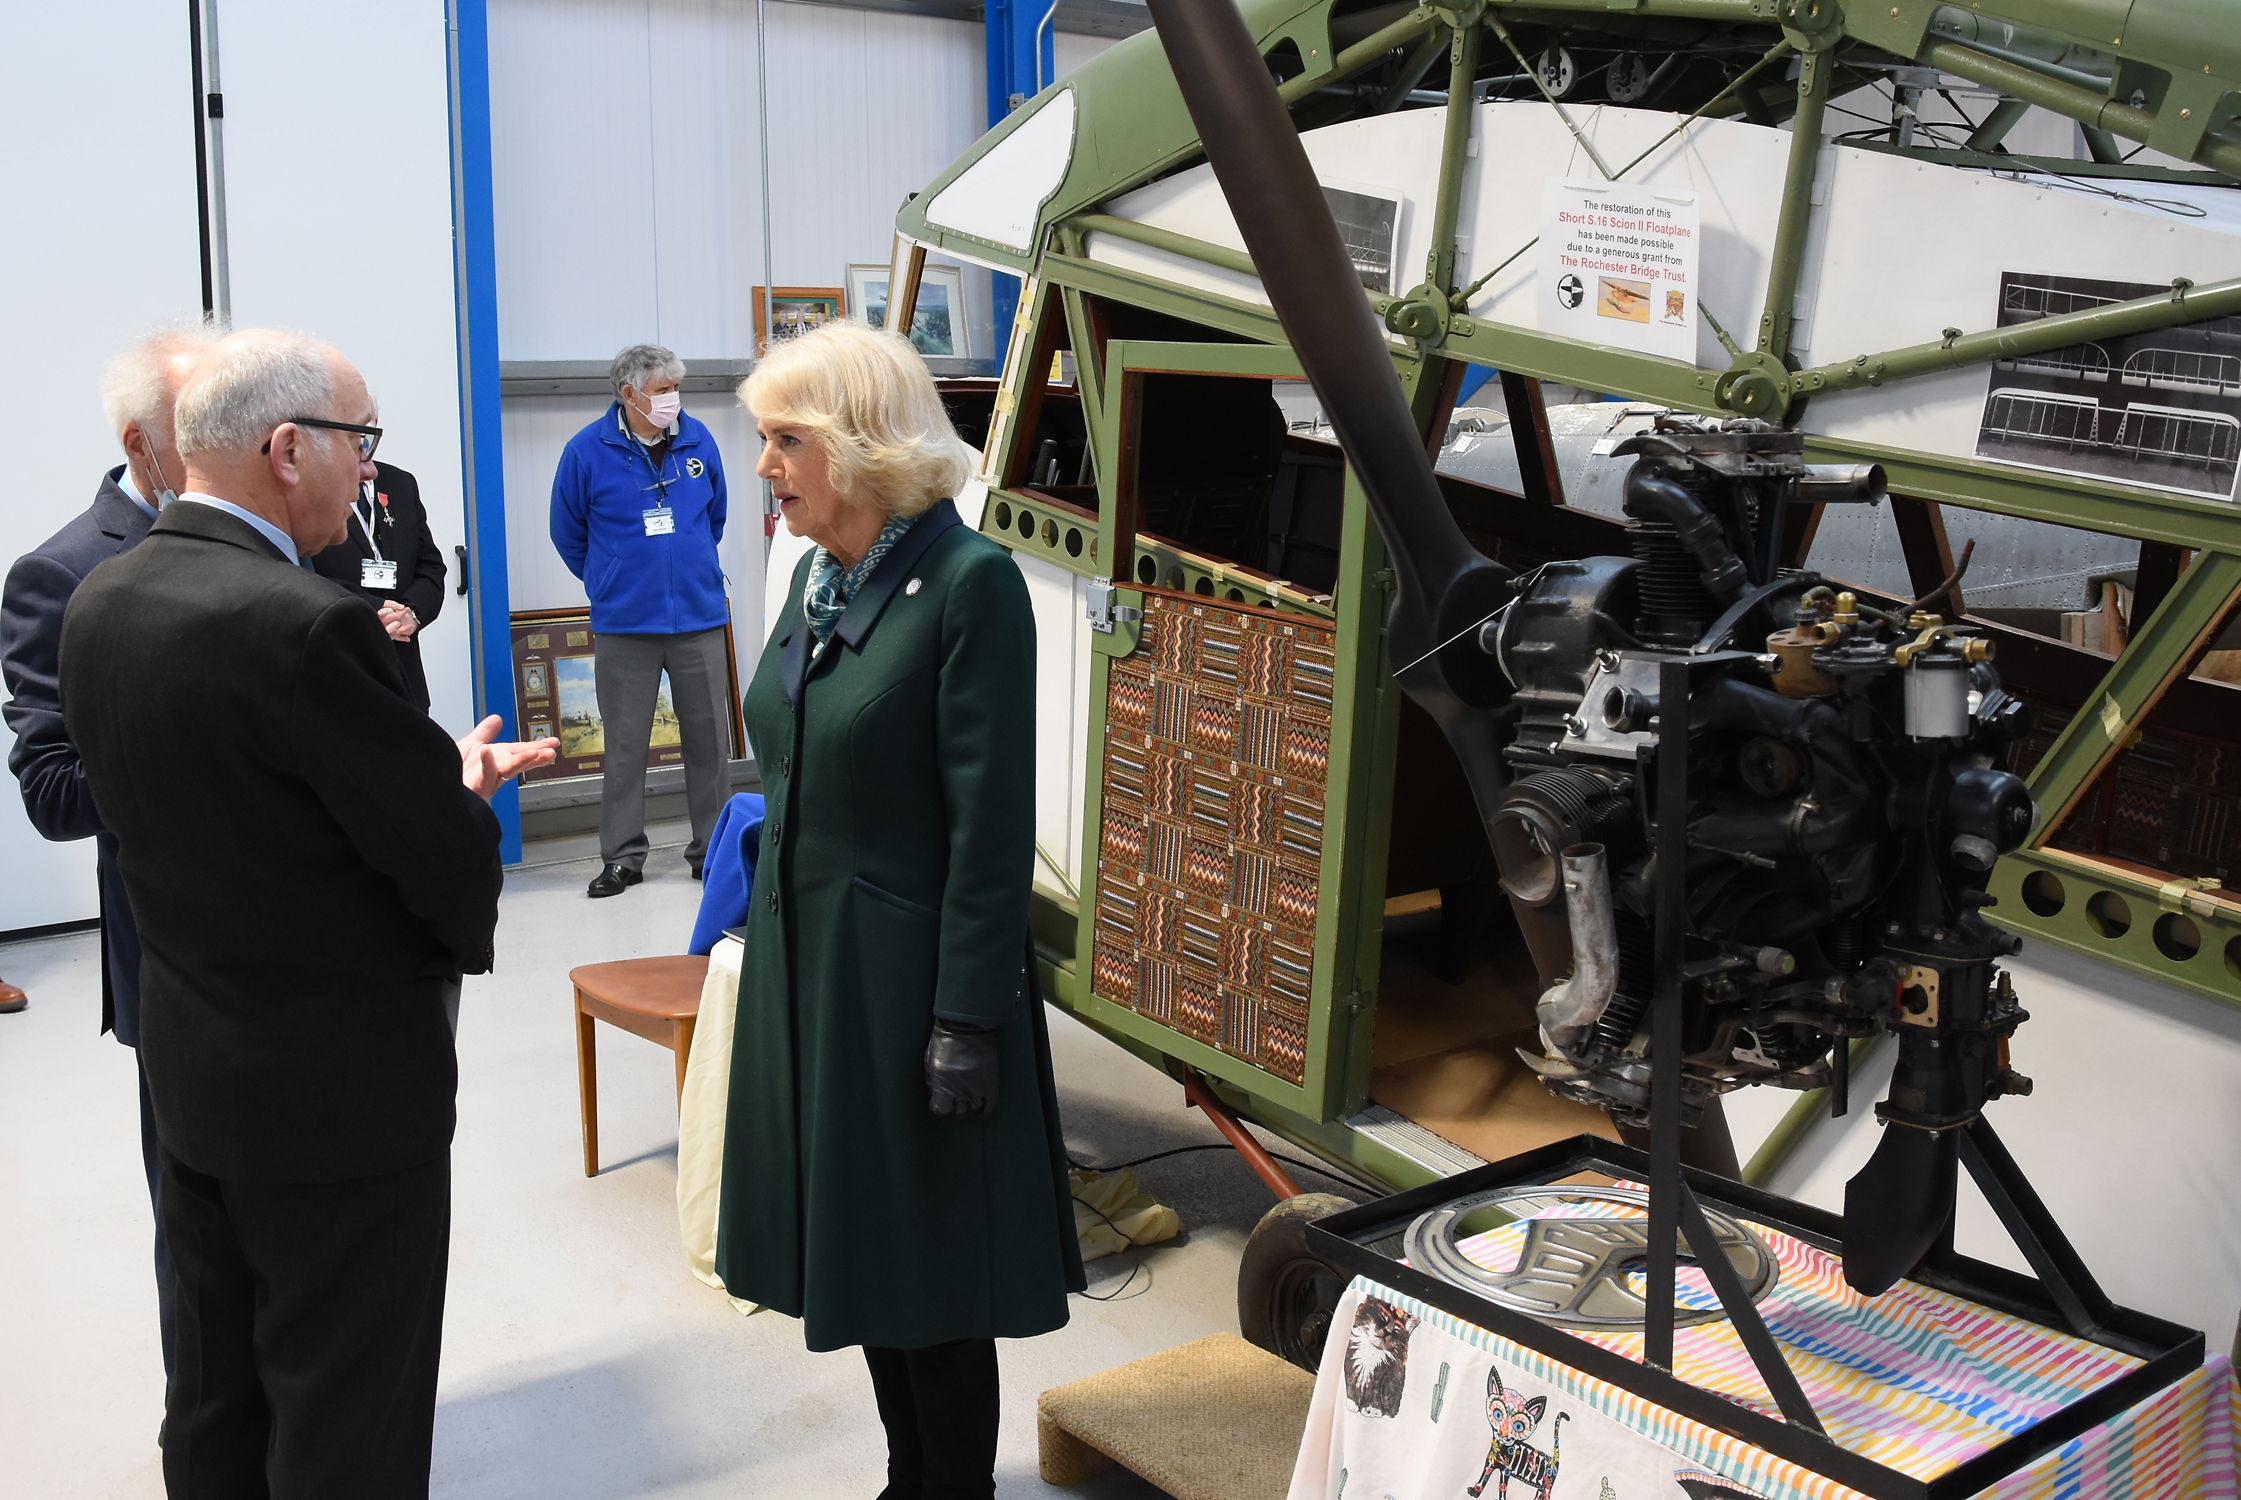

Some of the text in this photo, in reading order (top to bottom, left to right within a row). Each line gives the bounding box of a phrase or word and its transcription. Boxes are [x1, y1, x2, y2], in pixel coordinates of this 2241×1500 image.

[1584, 200, 1671, 218] The restoration of this
[1559, 212, 1585, 224] Short
[1587, 215, 1608, 227] S.16
[1610, 217, 1636, 230] Scion
[1646, 222, 1691, 238] Floatplane
[1578, 229, 1674, 250] has been made possible
[1567, 242, 1583, 251] due
[1585, 244, 1593, 253] to
[1602, 248, 1640, 260] generous
[1642, 253, 1663, 263] grant
[1664, 255, 1683, 266] from
[1560, 255, 1686, 283] The Rochester Bridge Trust.
